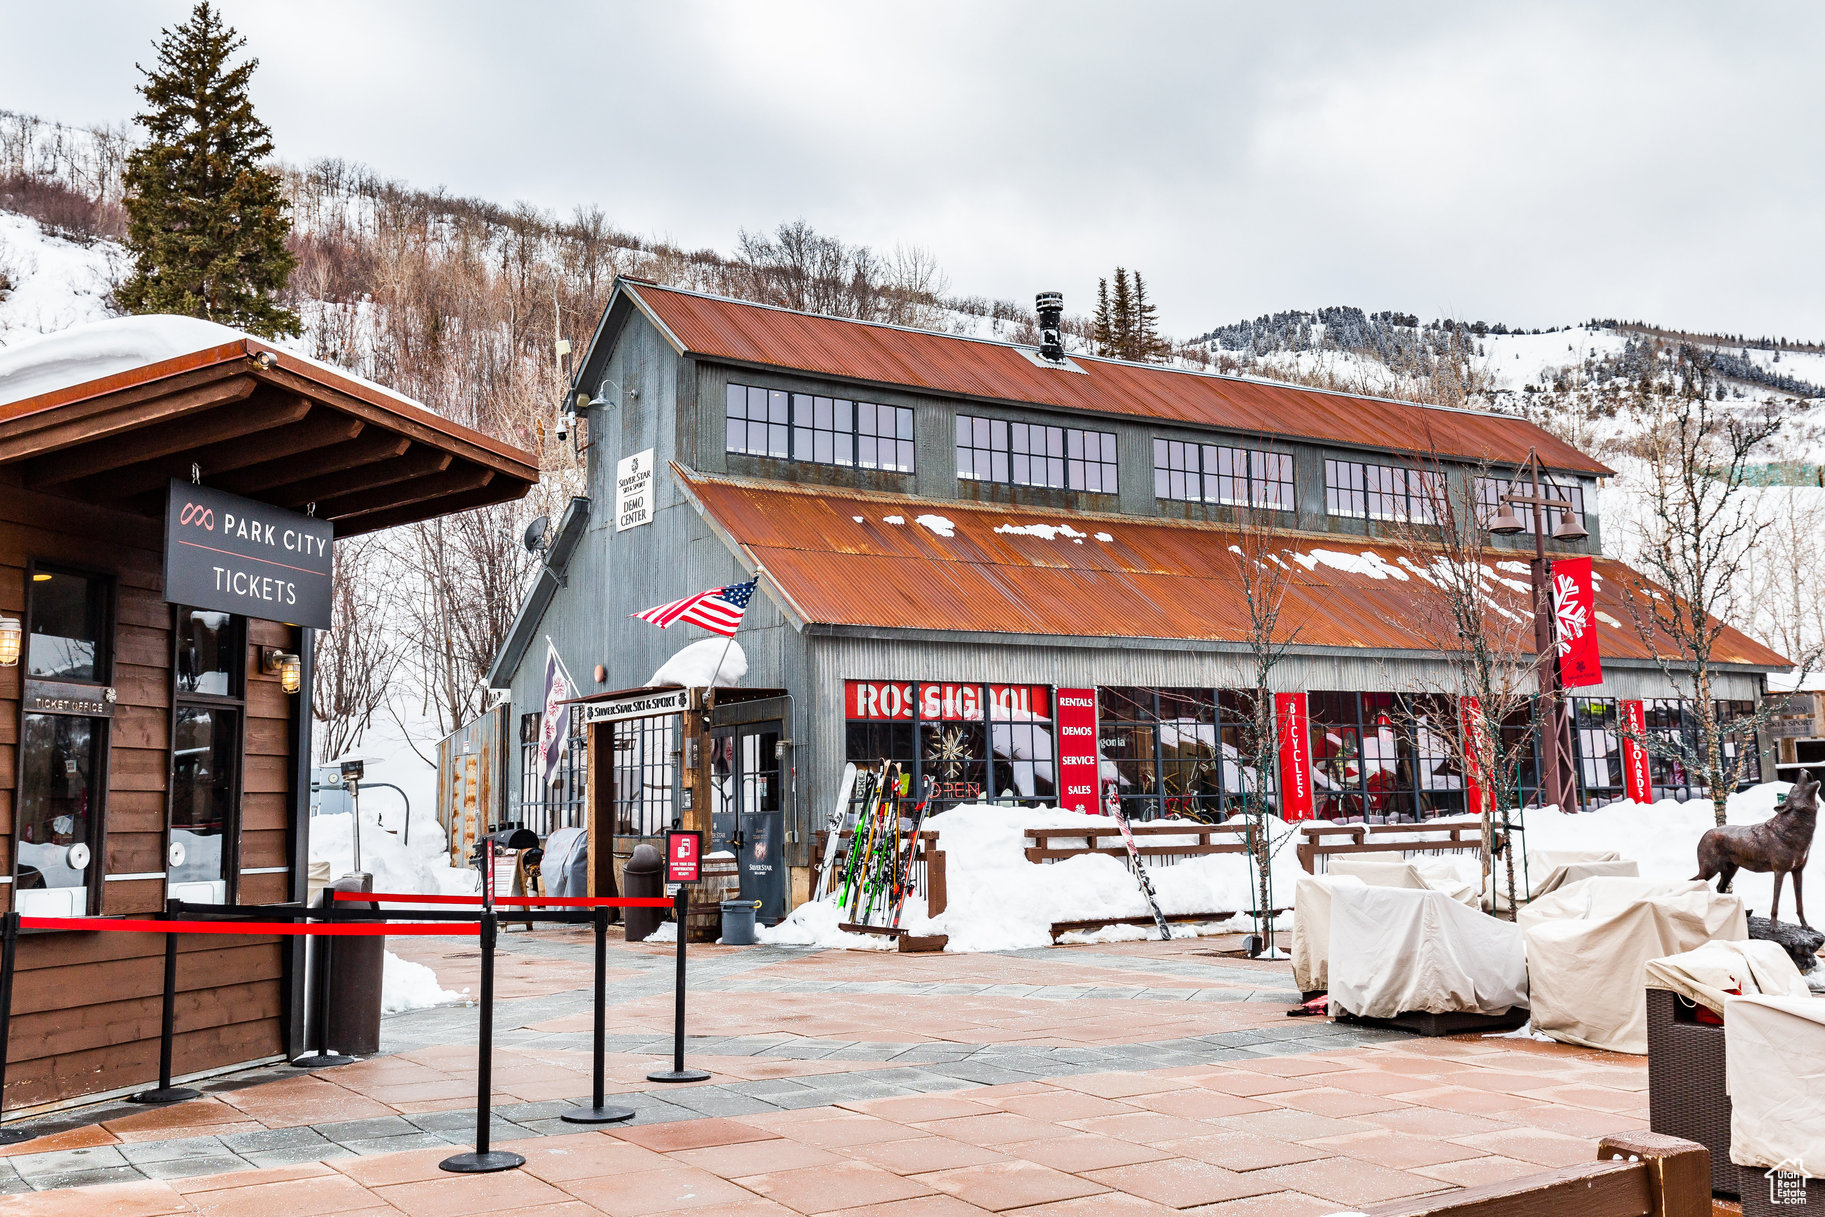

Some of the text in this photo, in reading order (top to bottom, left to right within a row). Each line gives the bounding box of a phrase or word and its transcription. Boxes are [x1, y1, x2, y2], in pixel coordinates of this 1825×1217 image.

[618, 470, 651, 488] SILVER STAR
[632, 480, 646, 490] SPORT
[623, 496, 644, 513] DEMO
[620, 508, 647, 527] CENTER
[224, 513, 327, 557] PARK CITY
[212, 566, 296, 605] TICKETS
[35, 698, 103, 712] TICKET OFFICE
[594, 695, 677, 717] SILVER STAR SKI & SPORT
[856, 683, 1038, 719] ROSSIGNOL
[1060, 697, 1093, 707] RENTALS
[1062, 726, 1092, 736] DEMOS
[1289, 702, 1304, 798] BICYCLES
[1629, 703, 1645, 798] SNOBOARDS
[1062, 756, 1095, 765] SERVICE
[1068, 785, 1091, 795] SALES
[761, 863, 773, 871] STAR
